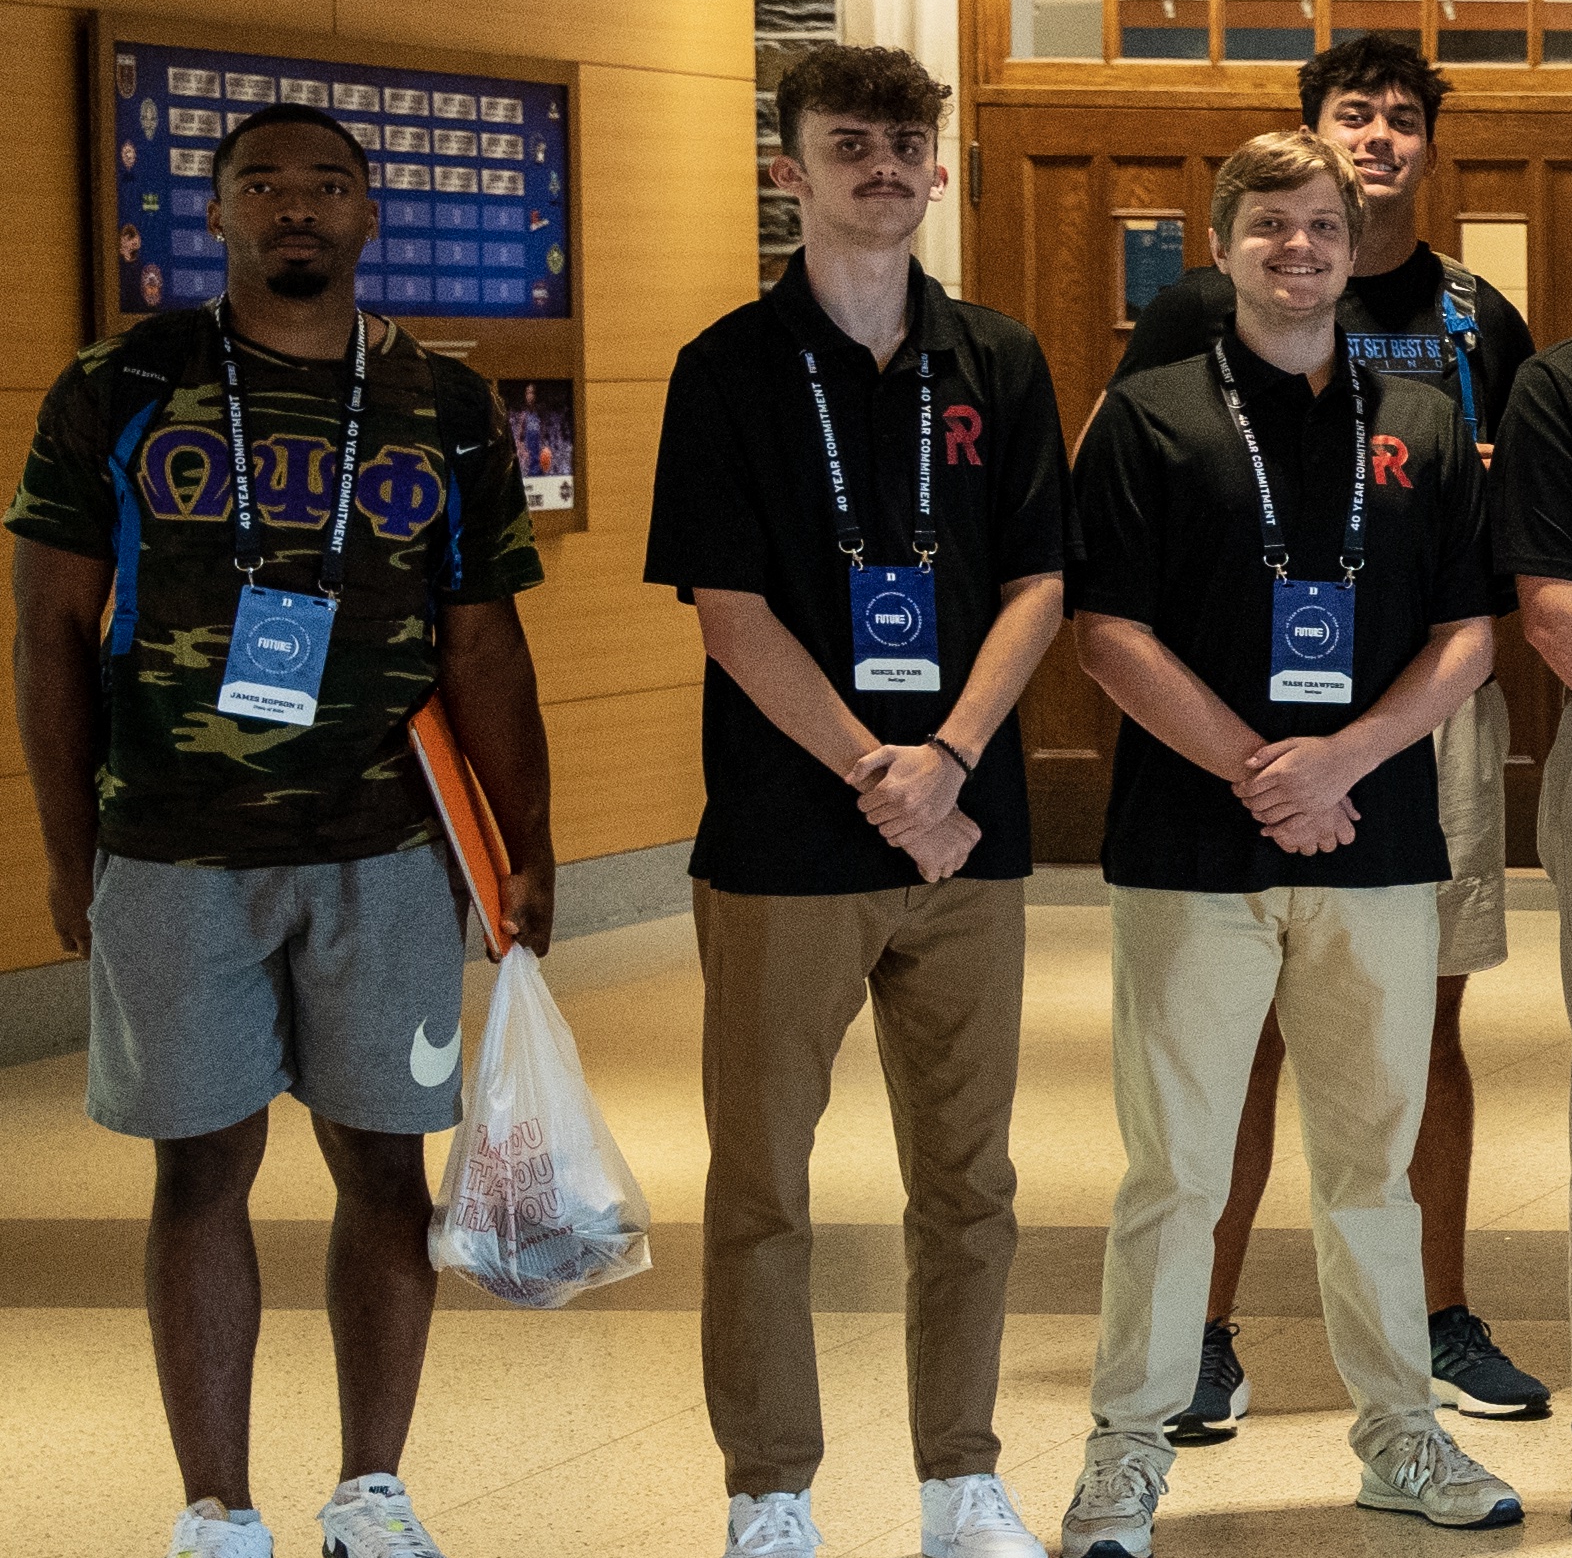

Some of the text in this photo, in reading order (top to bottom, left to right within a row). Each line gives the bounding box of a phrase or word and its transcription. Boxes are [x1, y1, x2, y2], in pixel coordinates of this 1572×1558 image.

[1347, 338, 1442, 359] ST SET BEST SE
[229, 394, 251, 530] 40 YEAR COMMITMENT
[331, 421, 359, 554] 40 YEAR COMMITMENT
[811, 382, 848, 512] 40 YEAR COMMITMENT
[920, 386, 932, 515] 40 YEAR COMMITMENT
[942, 404, 983, 466] R
[1238, 414, 1276, 526] 40 YEAR COMMITMENT
[1350, 420, 1366, 531] 40 YEAR COMMITMENT
[1370, 434, 1414, 489] R
[230, 691, 260, 703] JAMES
